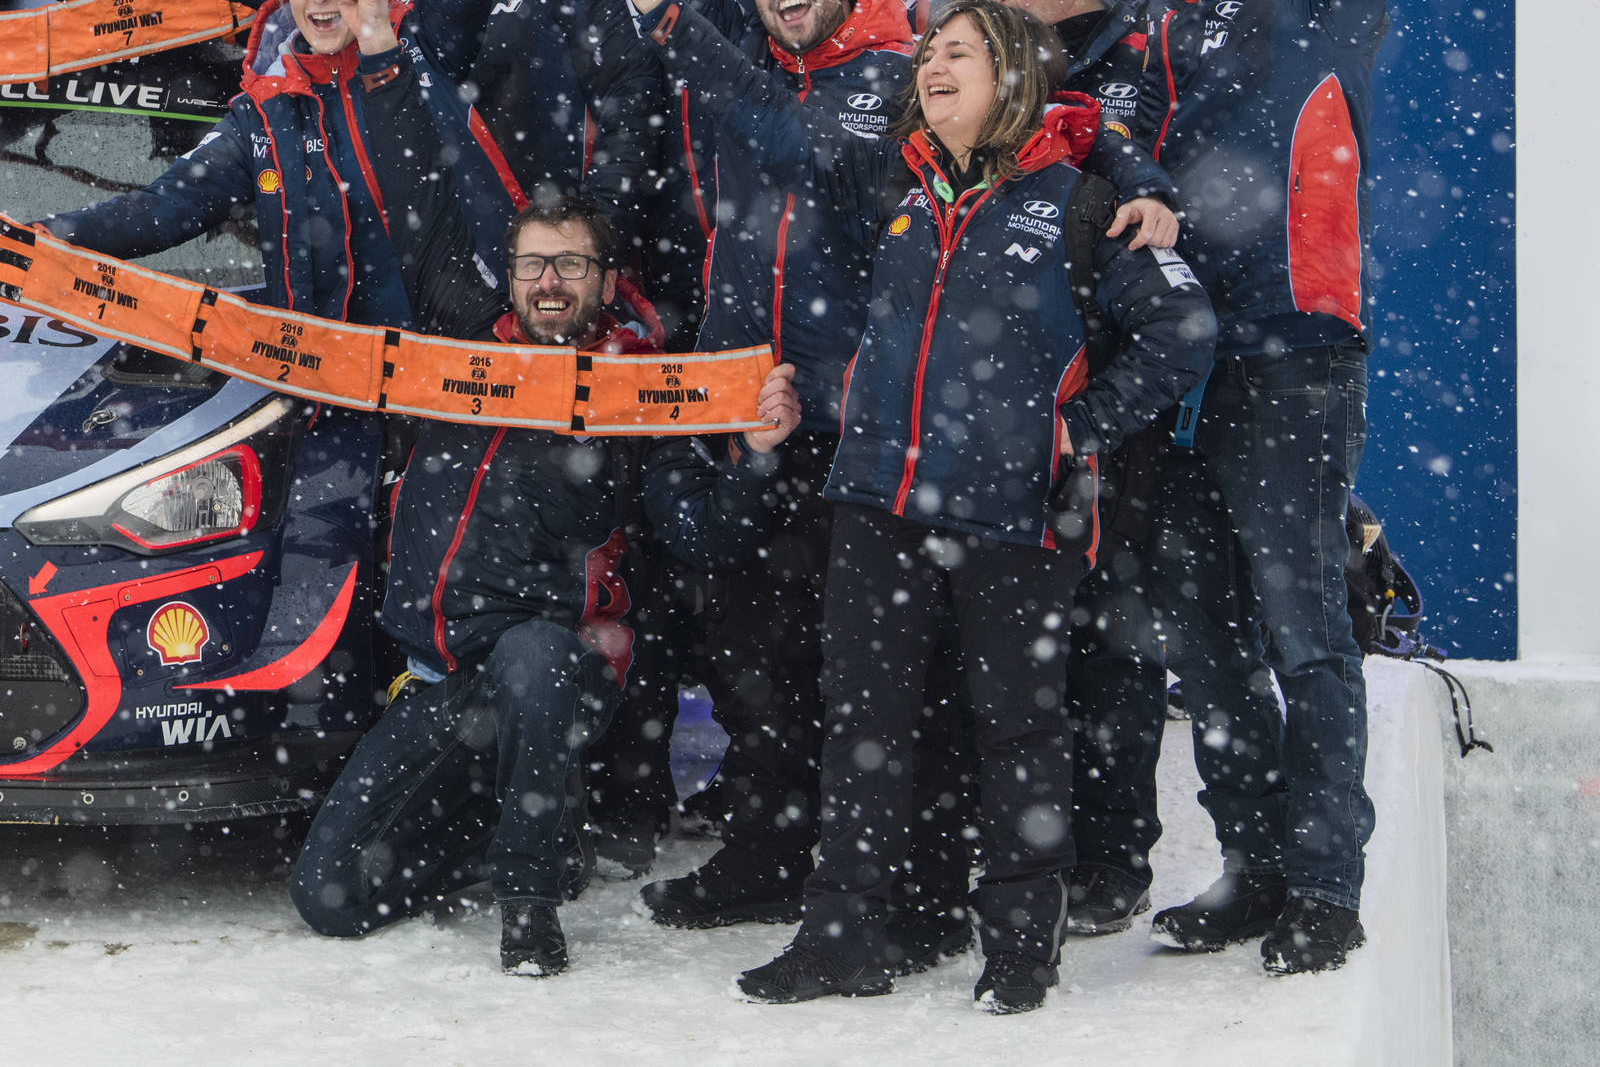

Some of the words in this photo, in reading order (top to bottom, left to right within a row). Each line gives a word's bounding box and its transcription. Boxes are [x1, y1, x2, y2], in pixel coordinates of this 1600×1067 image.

[94, 14, 138, 36] HYUNDAI
[138, 12, 163, 27] WRT
[123, 30, 133, 46] 7
[64, 80, 163, 109] LIVE
[177, 97, 229, 109] WRC.c
[838, 112, 888, 125] HYUNDAI
[1007, 221, 1058, 243] MOTORSPORT
[1009, 213, 1062, 235] HYUNDAI
[97, 262, 116, 276] 2018
[73, 277, 116, 301] HYUNDAI
[114, 290, 138, 310] WRT
[98, 303, 106, 319] 1
[280, 322, 303, 336] 2018
[251, 340, 298, 364] HYUNDAI
[298, 352, 322, 371] WRT
[277, 364, 291, 382] 2
[661, 364, 683, 374] 2018
[442, 379, 488, 396] HYUNDAI
[490, 383, 516, 399] WRT
[638, 389, 684, 403] HYUNDAI
[686, 388, 709, 402] WRT
[471, 398, 483, 415] 3
[670, 405, 680, 420] 4
[135, 702, 202, 719] HYUNDAI
